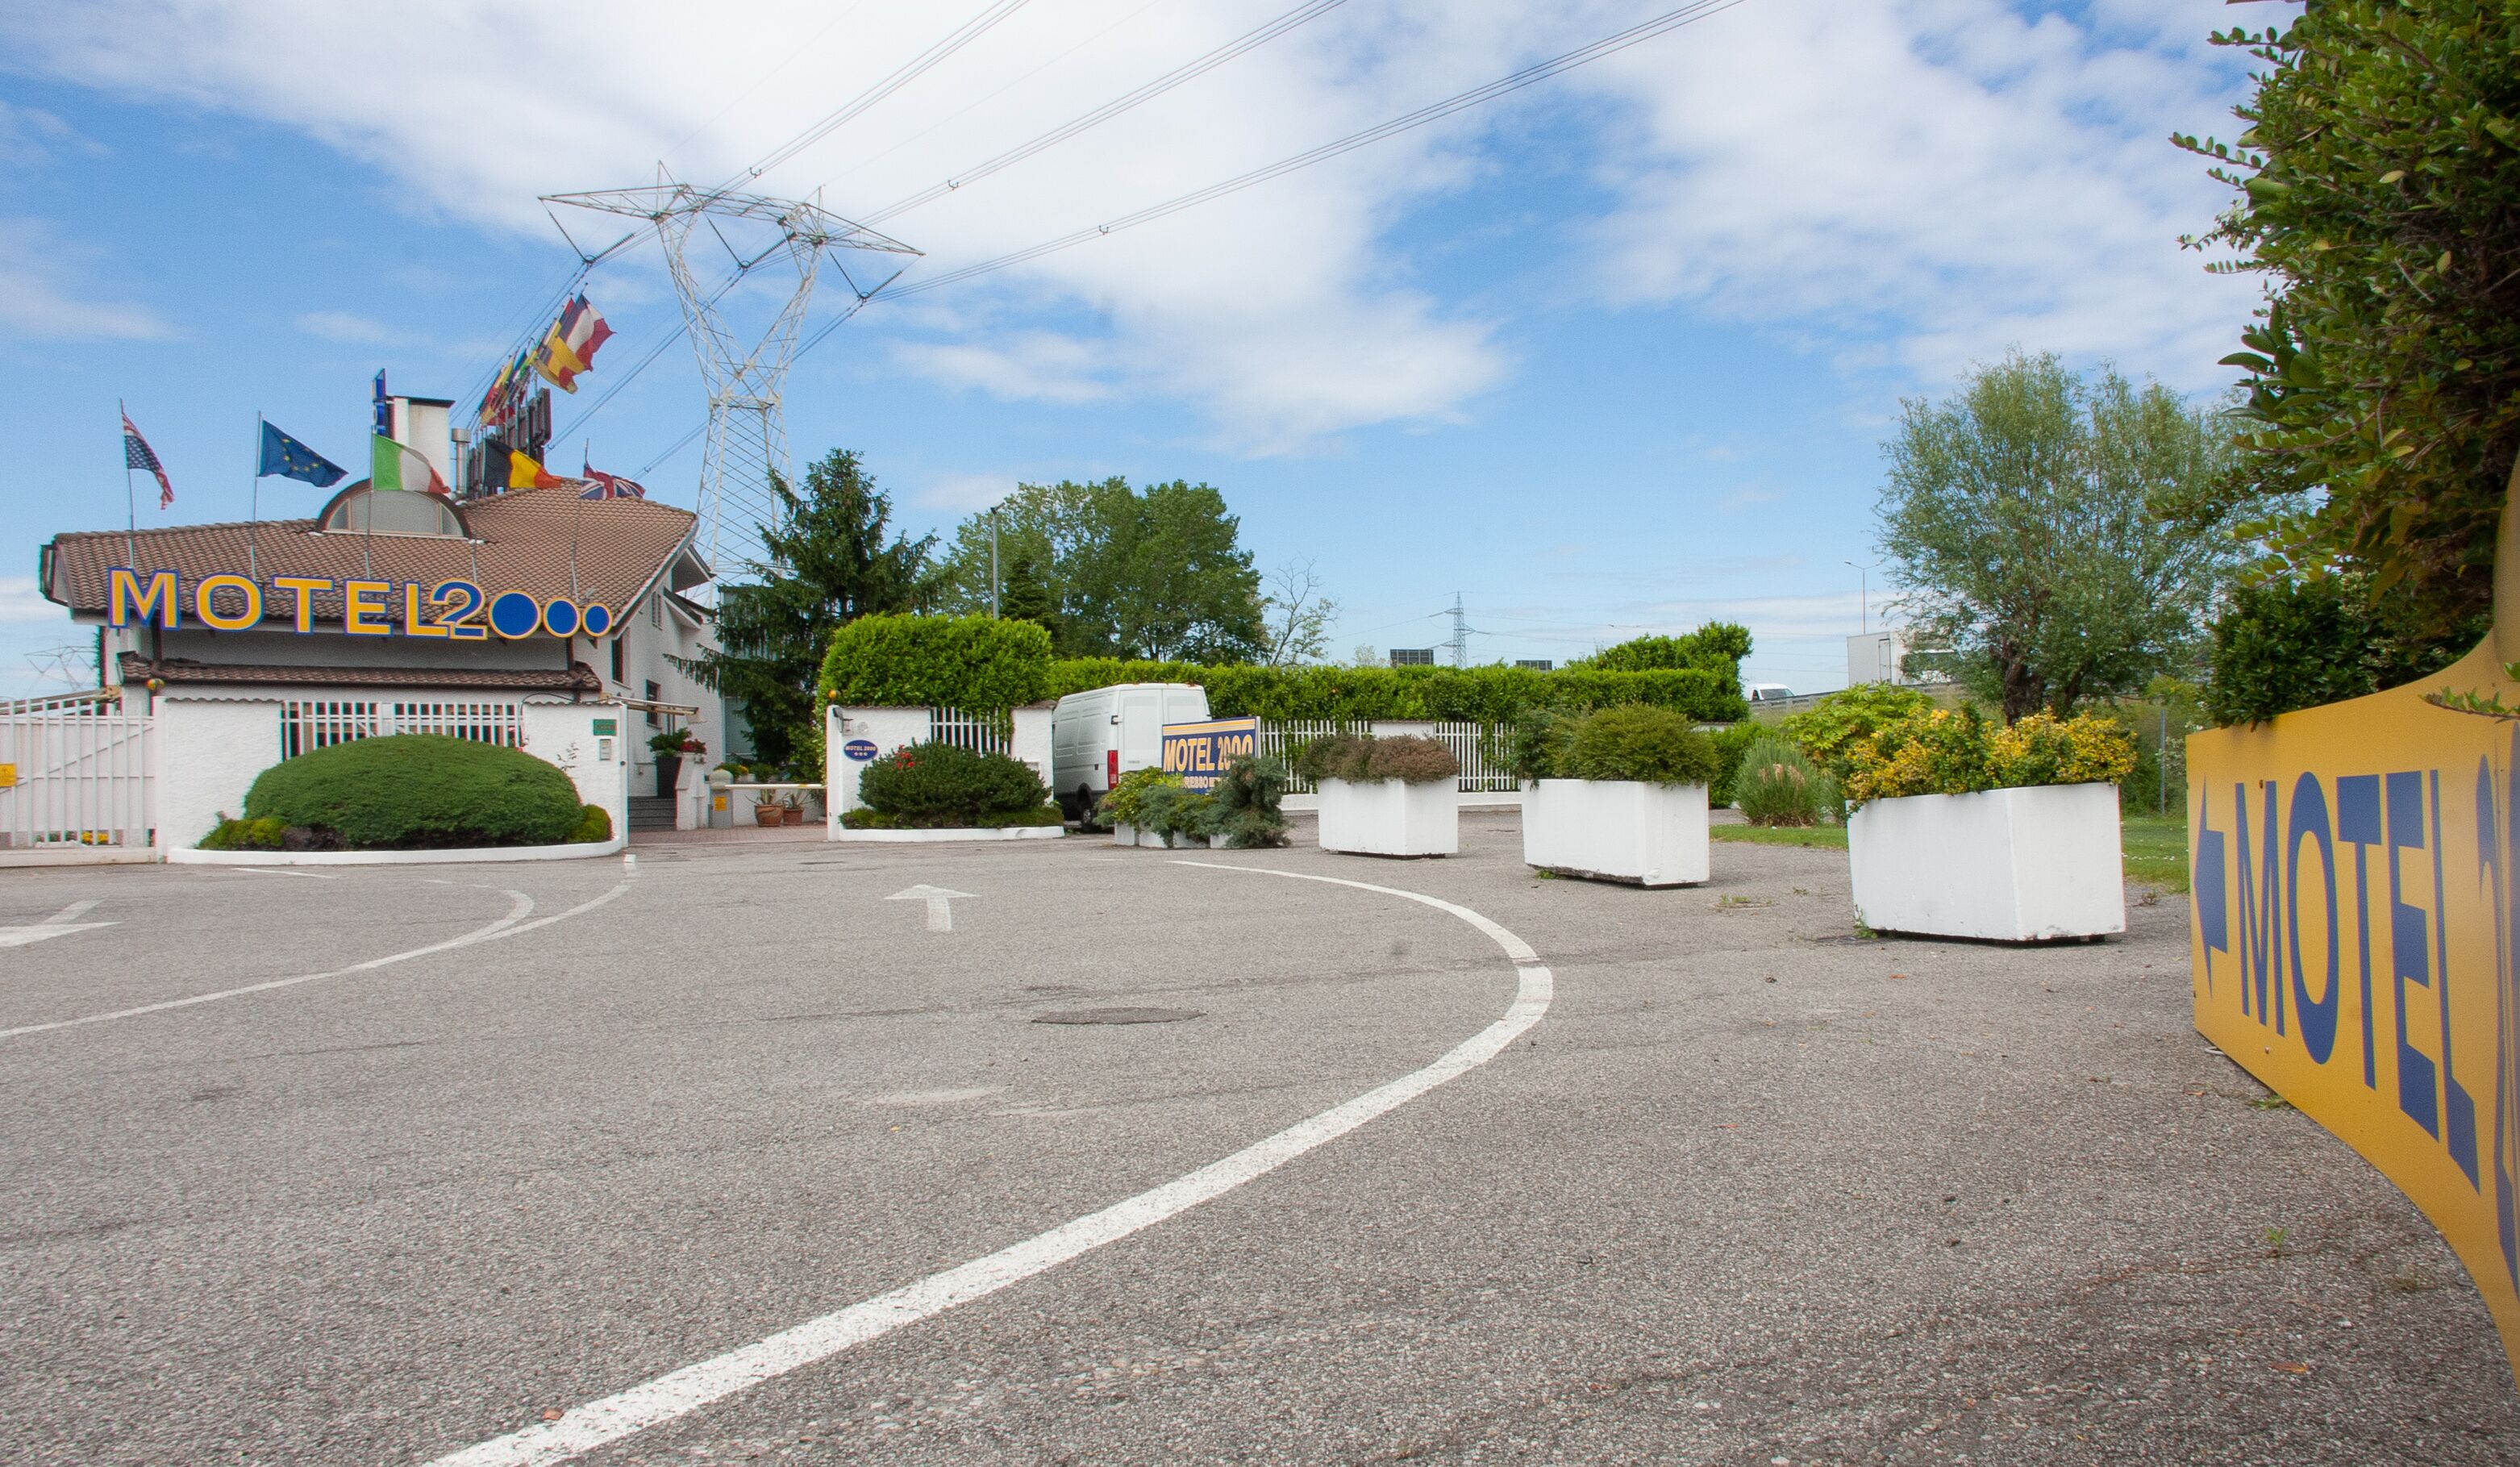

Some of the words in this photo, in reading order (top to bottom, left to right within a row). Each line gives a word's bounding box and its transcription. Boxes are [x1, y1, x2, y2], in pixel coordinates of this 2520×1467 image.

[107, 566, 450, 640] MOTEL
[429, 577, 614, 640] 2000
[1163, 737, 1215, 773] MOTEL
[2235, 769, 2480, 1195] MOTEL
